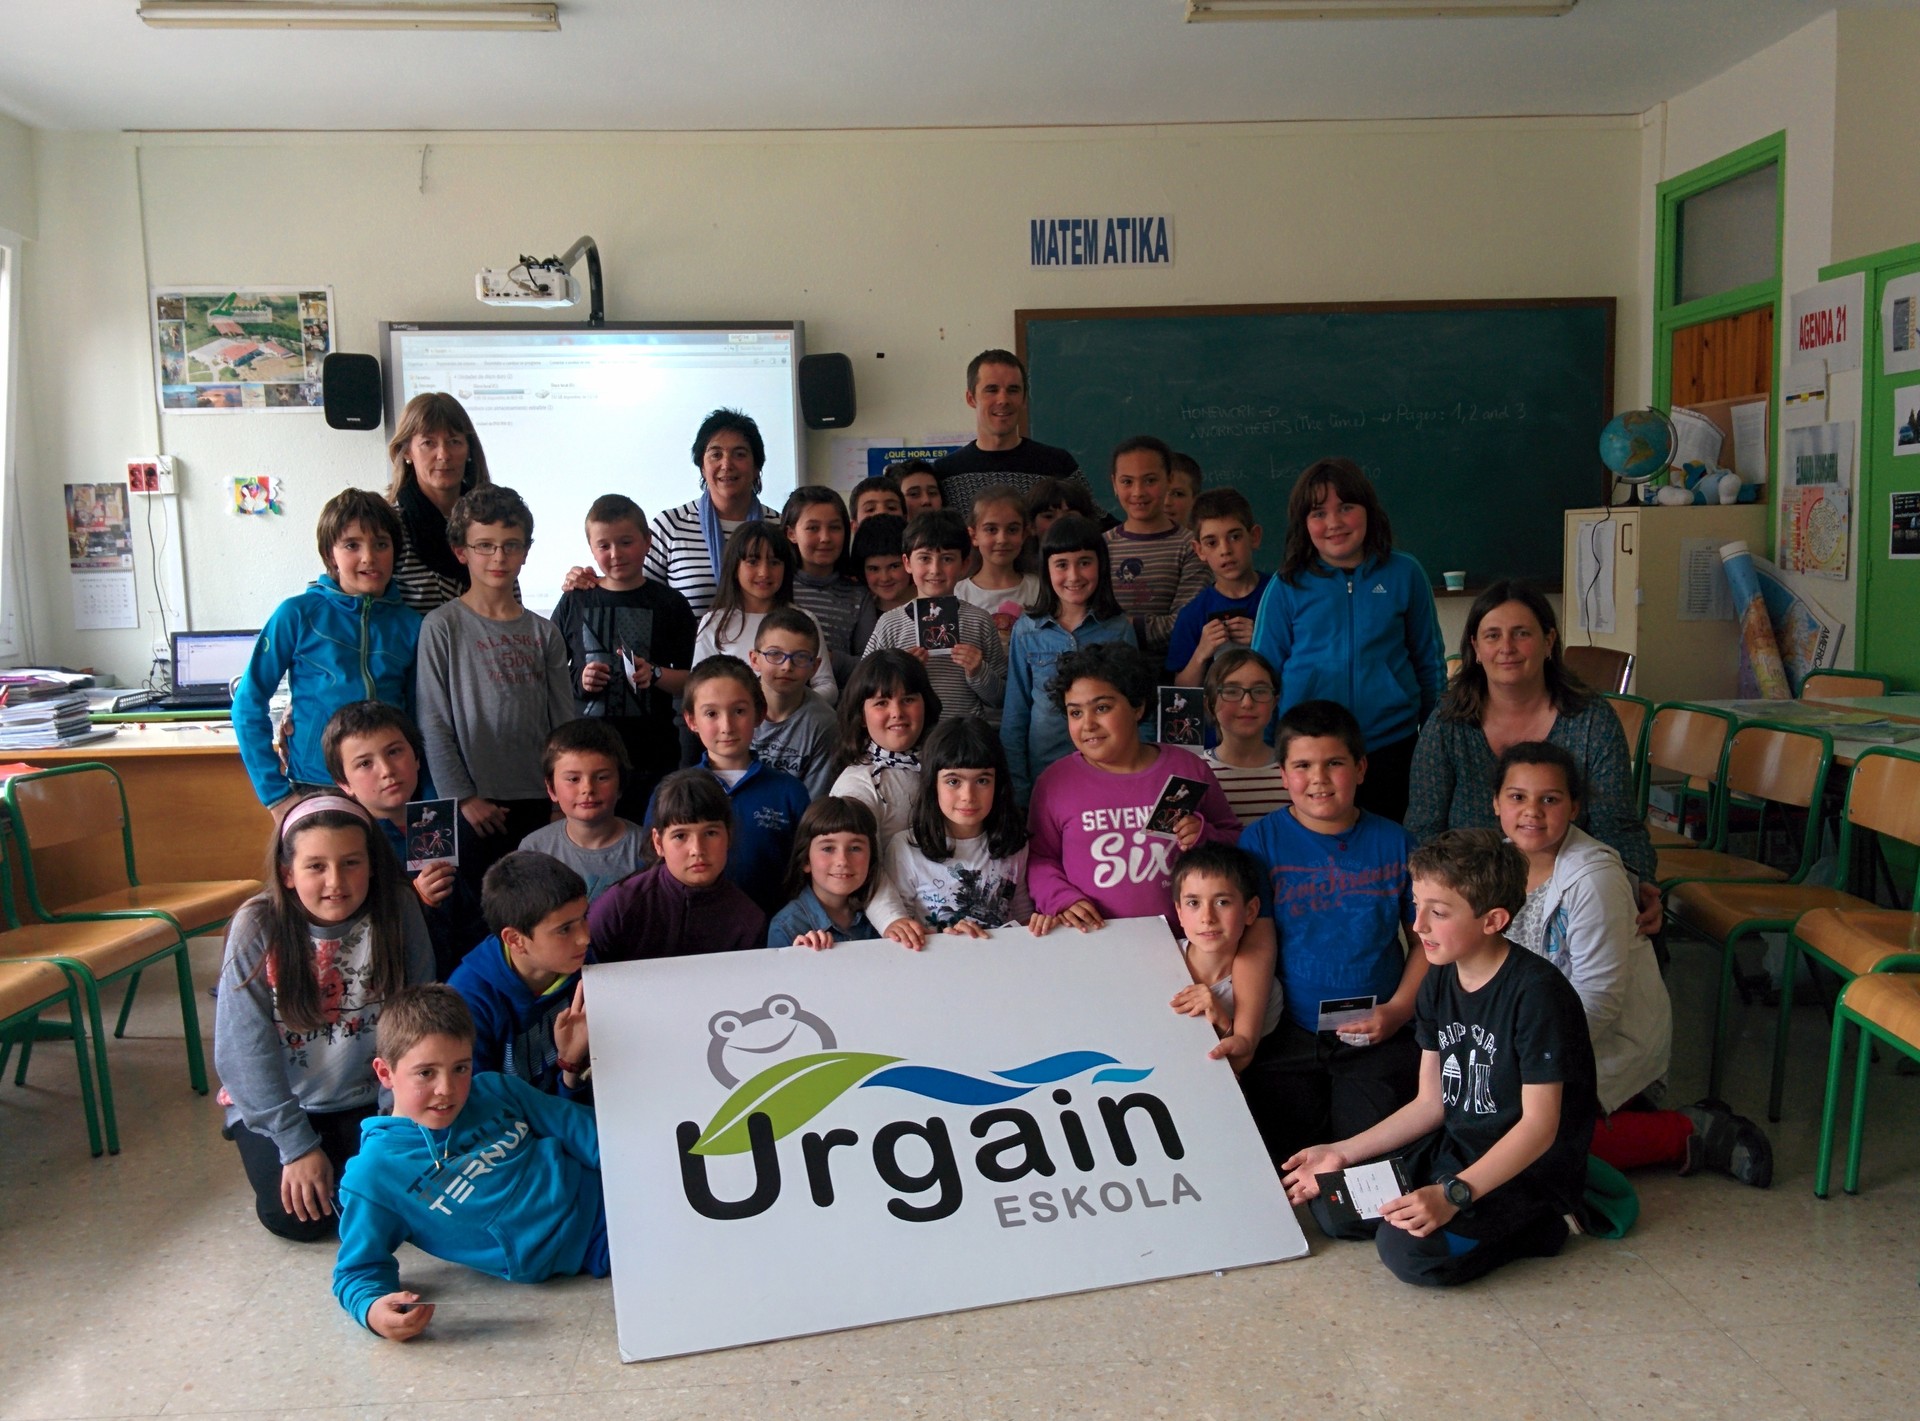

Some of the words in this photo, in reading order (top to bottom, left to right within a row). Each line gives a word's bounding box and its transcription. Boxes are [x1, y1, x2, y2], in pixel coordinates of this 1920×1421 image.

[1798, 308, 1835, 352] AGENDA
[1836, 304, 1847, 343] 21
[1194, 419, 1292, 439] WORKSHEETS
[1481, 404, 1510, 420] and
[1516, 403, 1526, 419] 3
[908, 450, 931, 459] HORA
[1081, 804, 1155, 832] SEVEN
[1090, 831, 1173, 888] Six
[1438, 1022, 1466, 1051] RIP
[428, 1121, 529, 1216] TERNUA
[676, 1088, 1185, 1223] Urgain
[993, 1172, 1202, 1229] ESKOLA
